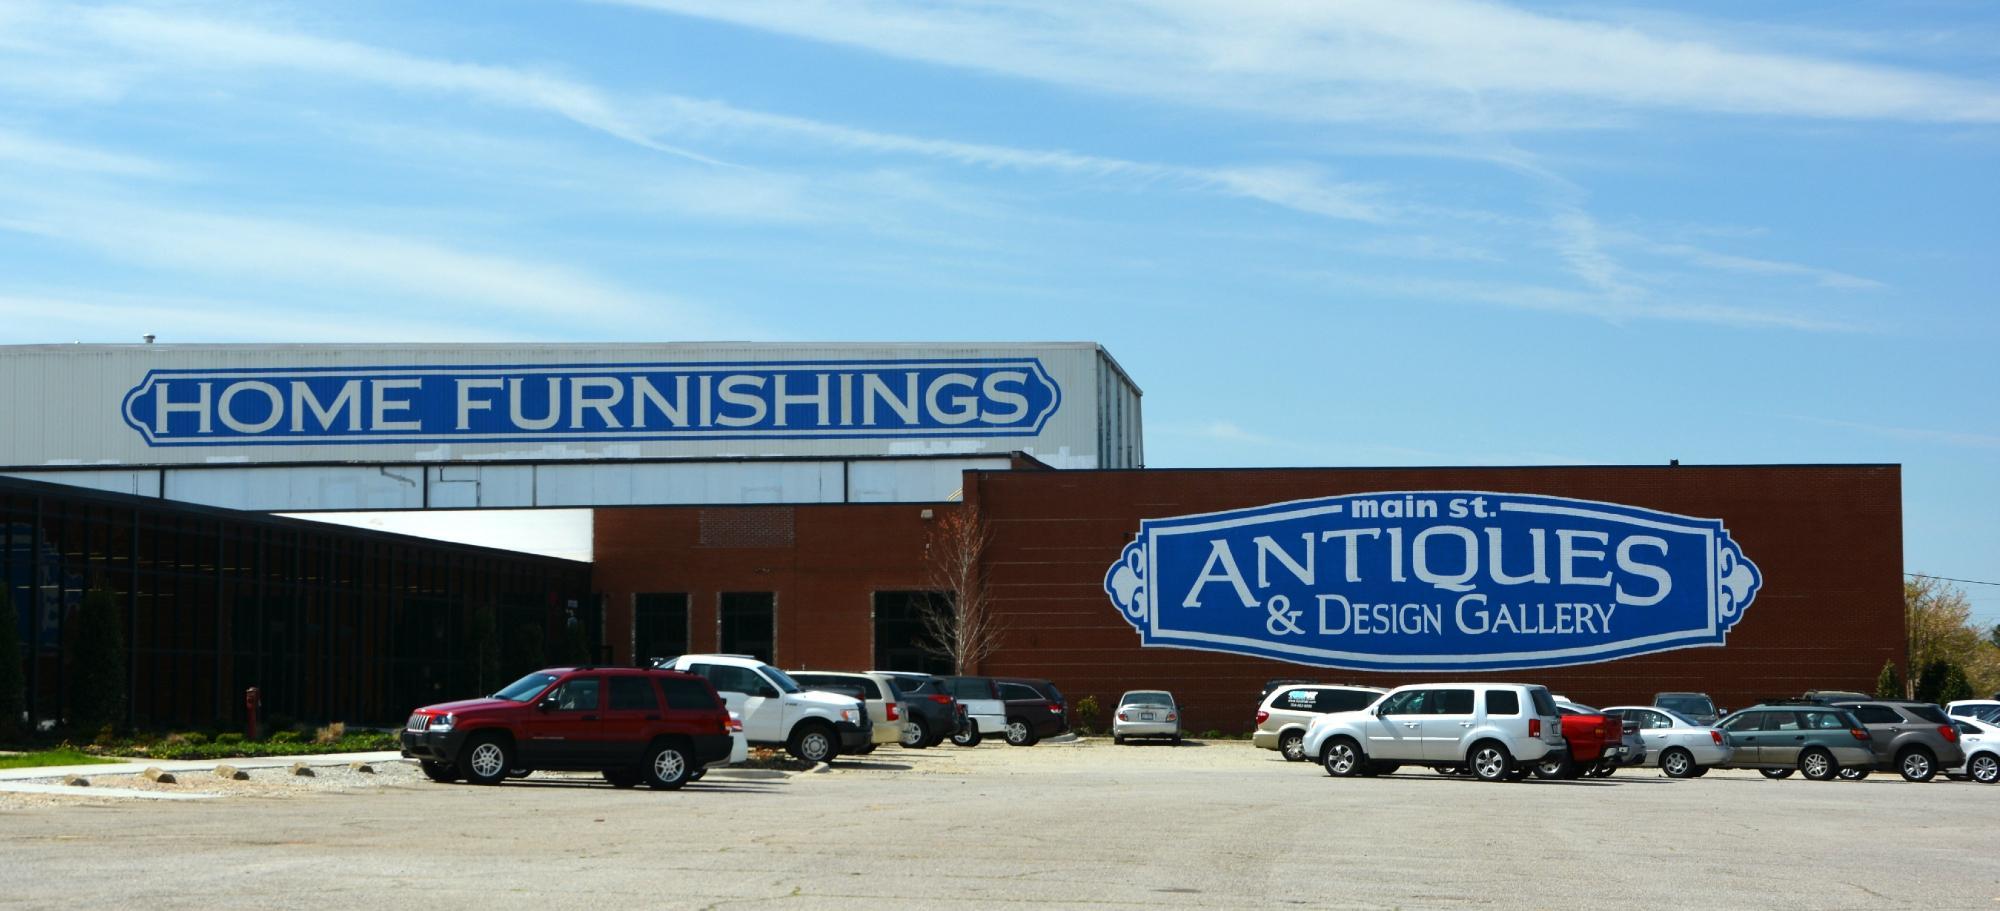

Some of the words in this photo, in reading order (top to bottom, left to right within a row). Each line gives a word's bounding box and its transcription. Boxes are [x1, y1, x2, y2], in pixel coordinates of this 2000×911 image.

[155, 378, 422, 434] HOME
[455, 371, 1030, 430] FURNISHINGS
[1351, 495, 1438, 518] main
[1449, 496, 1498, 518] st.
[1182, 525, 1673, 608] ANTIQUES
[1266, 594, 1306, 636] &
[1315, 594, 1442, 636] DESIGN
[1455, 593, 1617, 636] GALLERY
